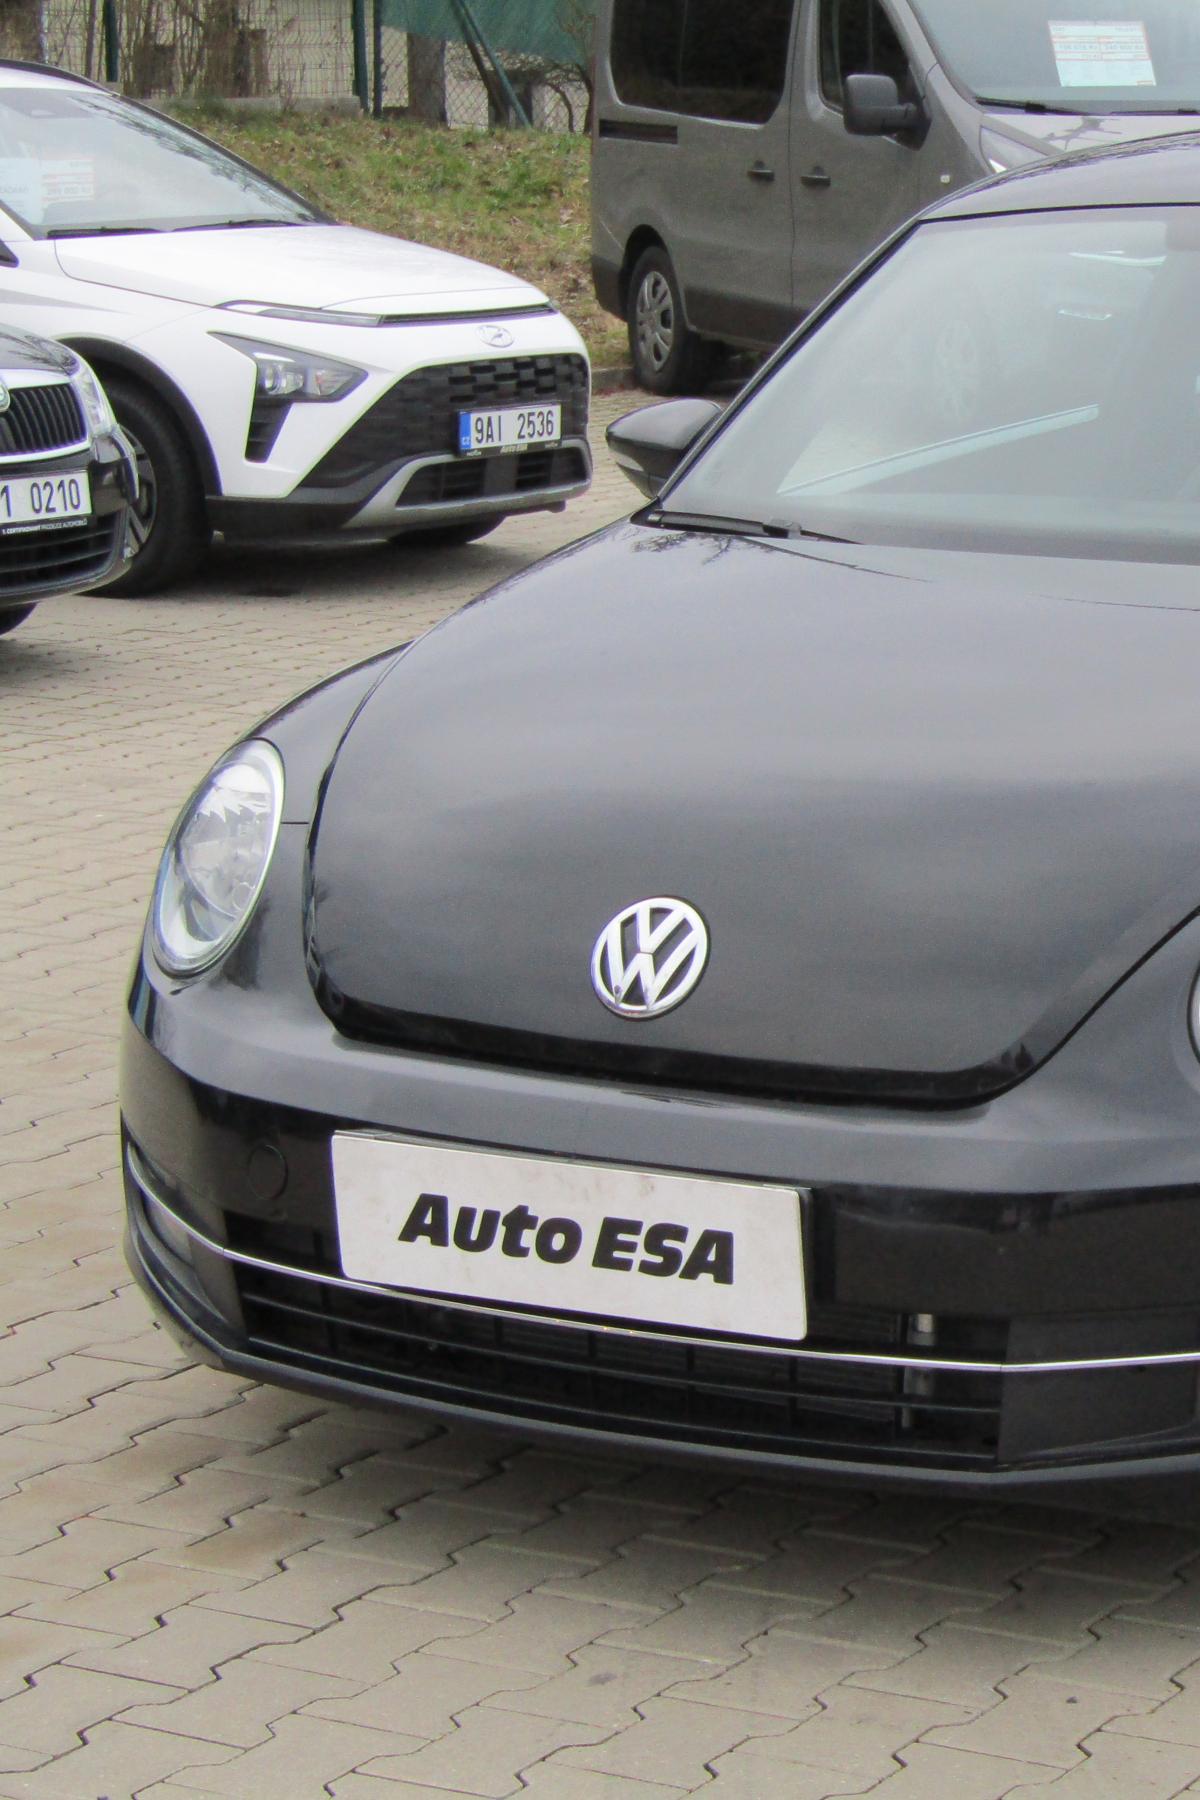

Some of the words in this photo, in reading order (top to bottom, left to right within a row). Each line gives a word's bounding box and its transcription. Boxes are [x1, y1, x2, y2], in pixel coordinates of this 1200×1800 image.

[475, 416, 501, 443] 9AI
[517, 410, 554, 440] 2536
[30, 478, 81, 514] 0210
[398, 1192, 583, 1265] Auto
[591, 1216, 734, 1286] ESA
